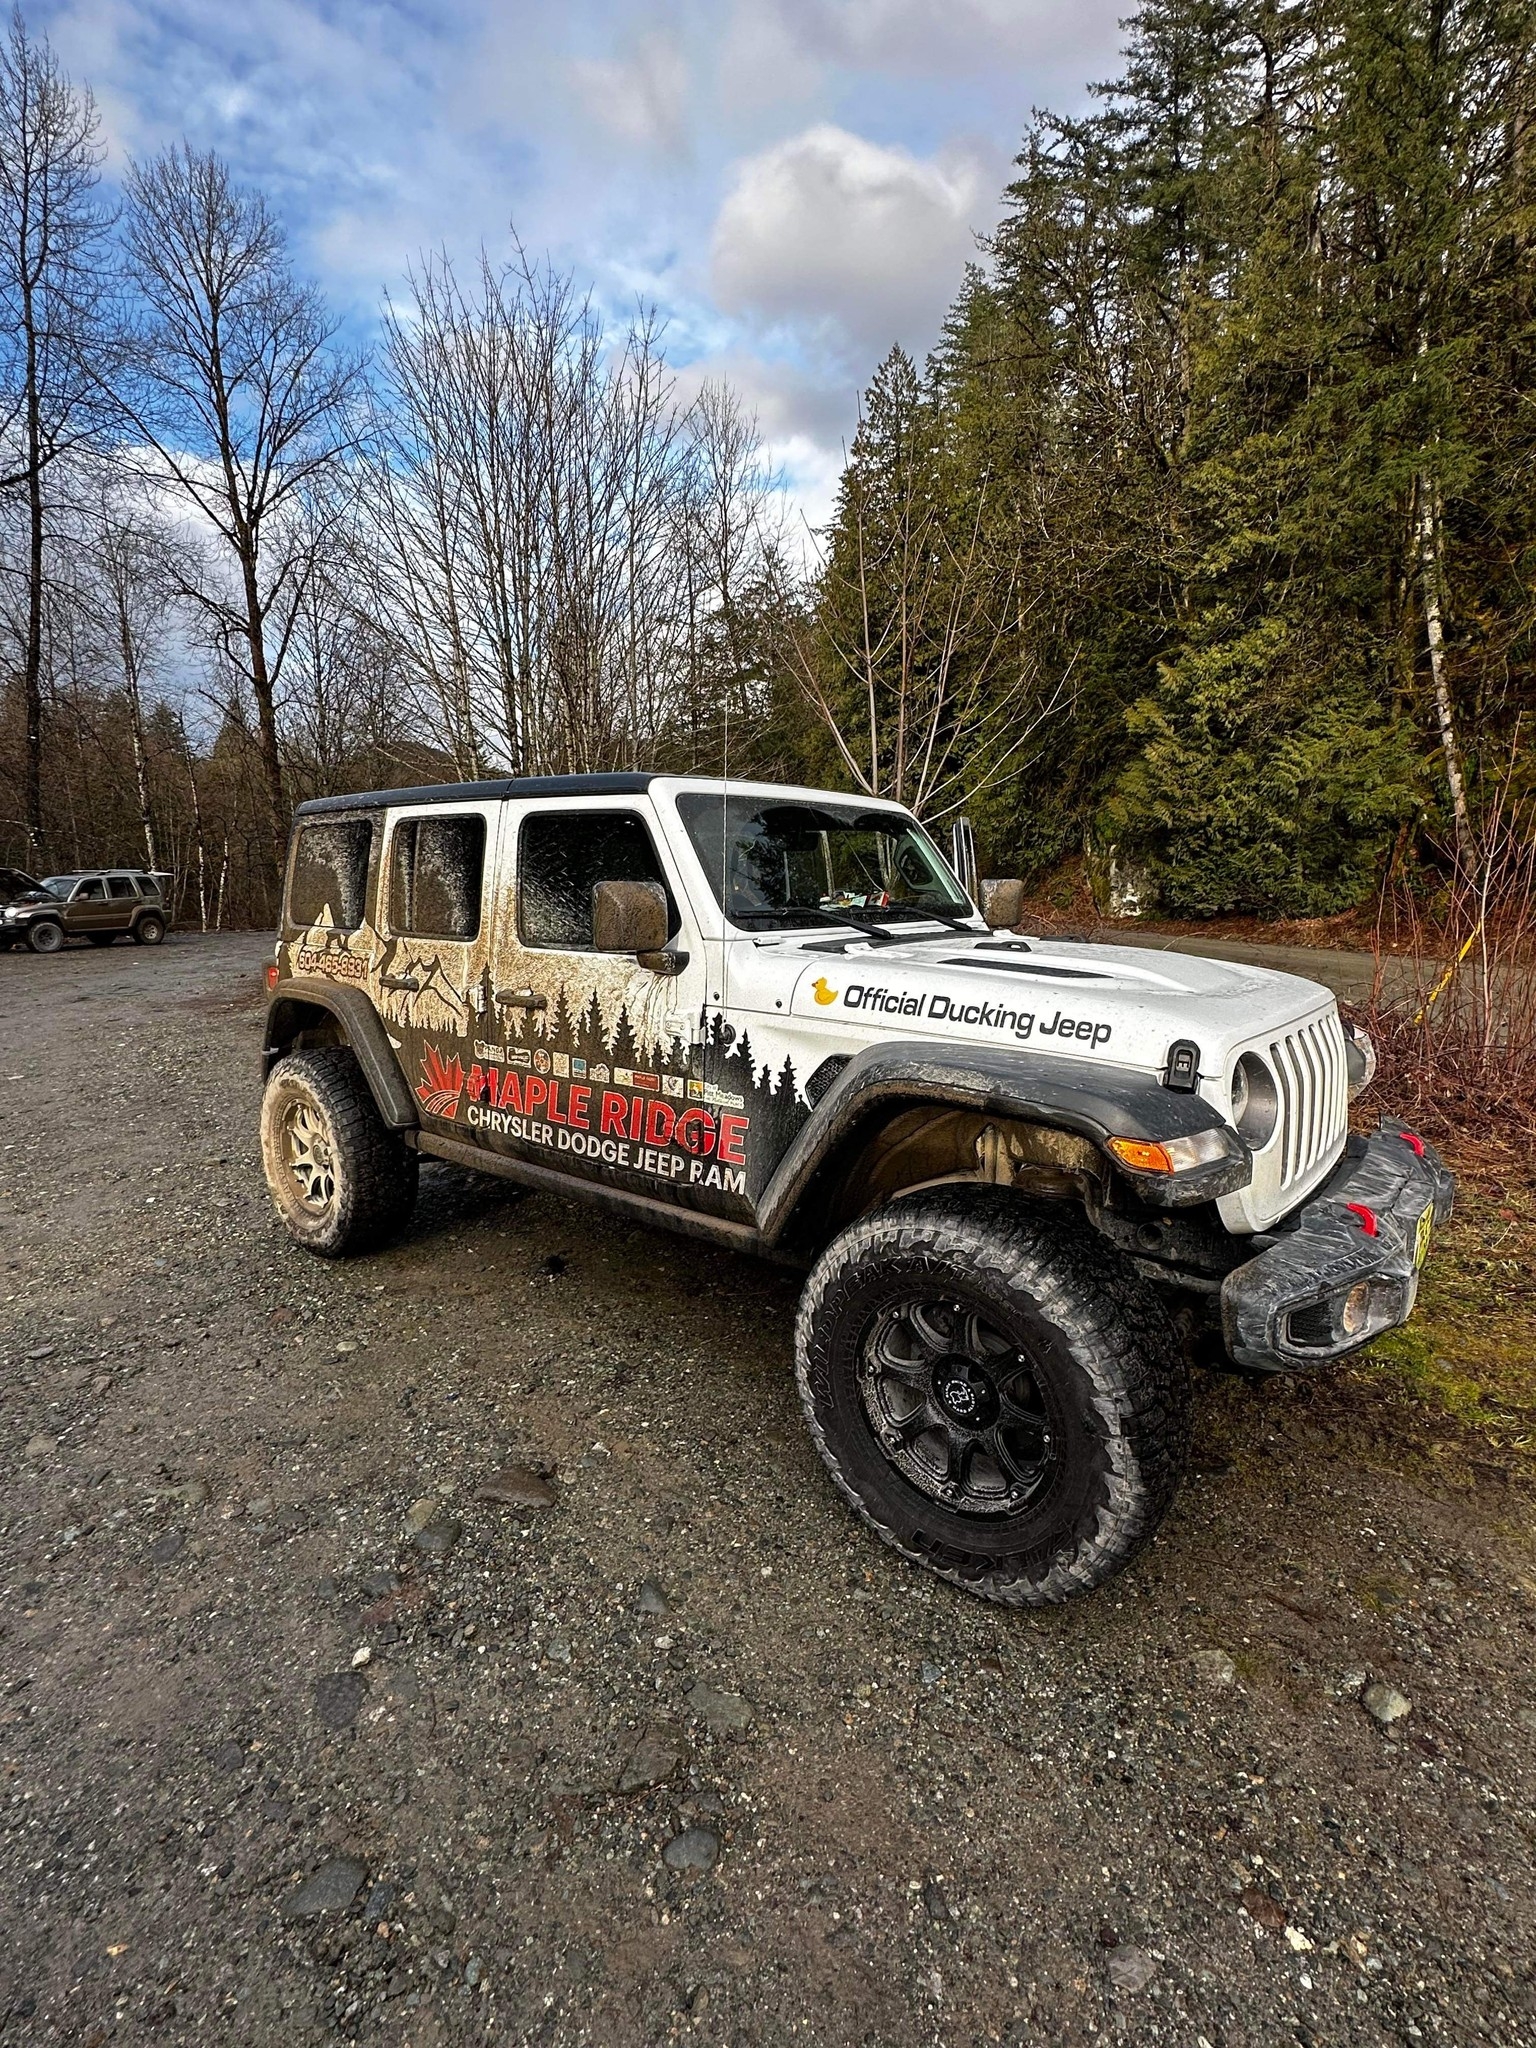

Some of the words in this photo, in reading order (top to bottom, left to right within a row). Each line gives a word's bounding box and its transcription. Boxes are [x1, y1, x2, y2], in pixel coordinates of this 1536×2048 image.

[843, 985, 926, 1017] Official
[927, 995, 1035, 1039] Ducking
[1039, 1011, 1112, 1049] Jeep
[466, 1063, 591, 1130] MAPLE
[600, 1091, 750, 1165] RIDGE
[467, 1105, 553, 1147] CHRYSLER
[557, 1128, 630, 1166] DODGE
[633, 1147, 685, 1178] JEEP
[690, 1160, 747, 1195] RAM
